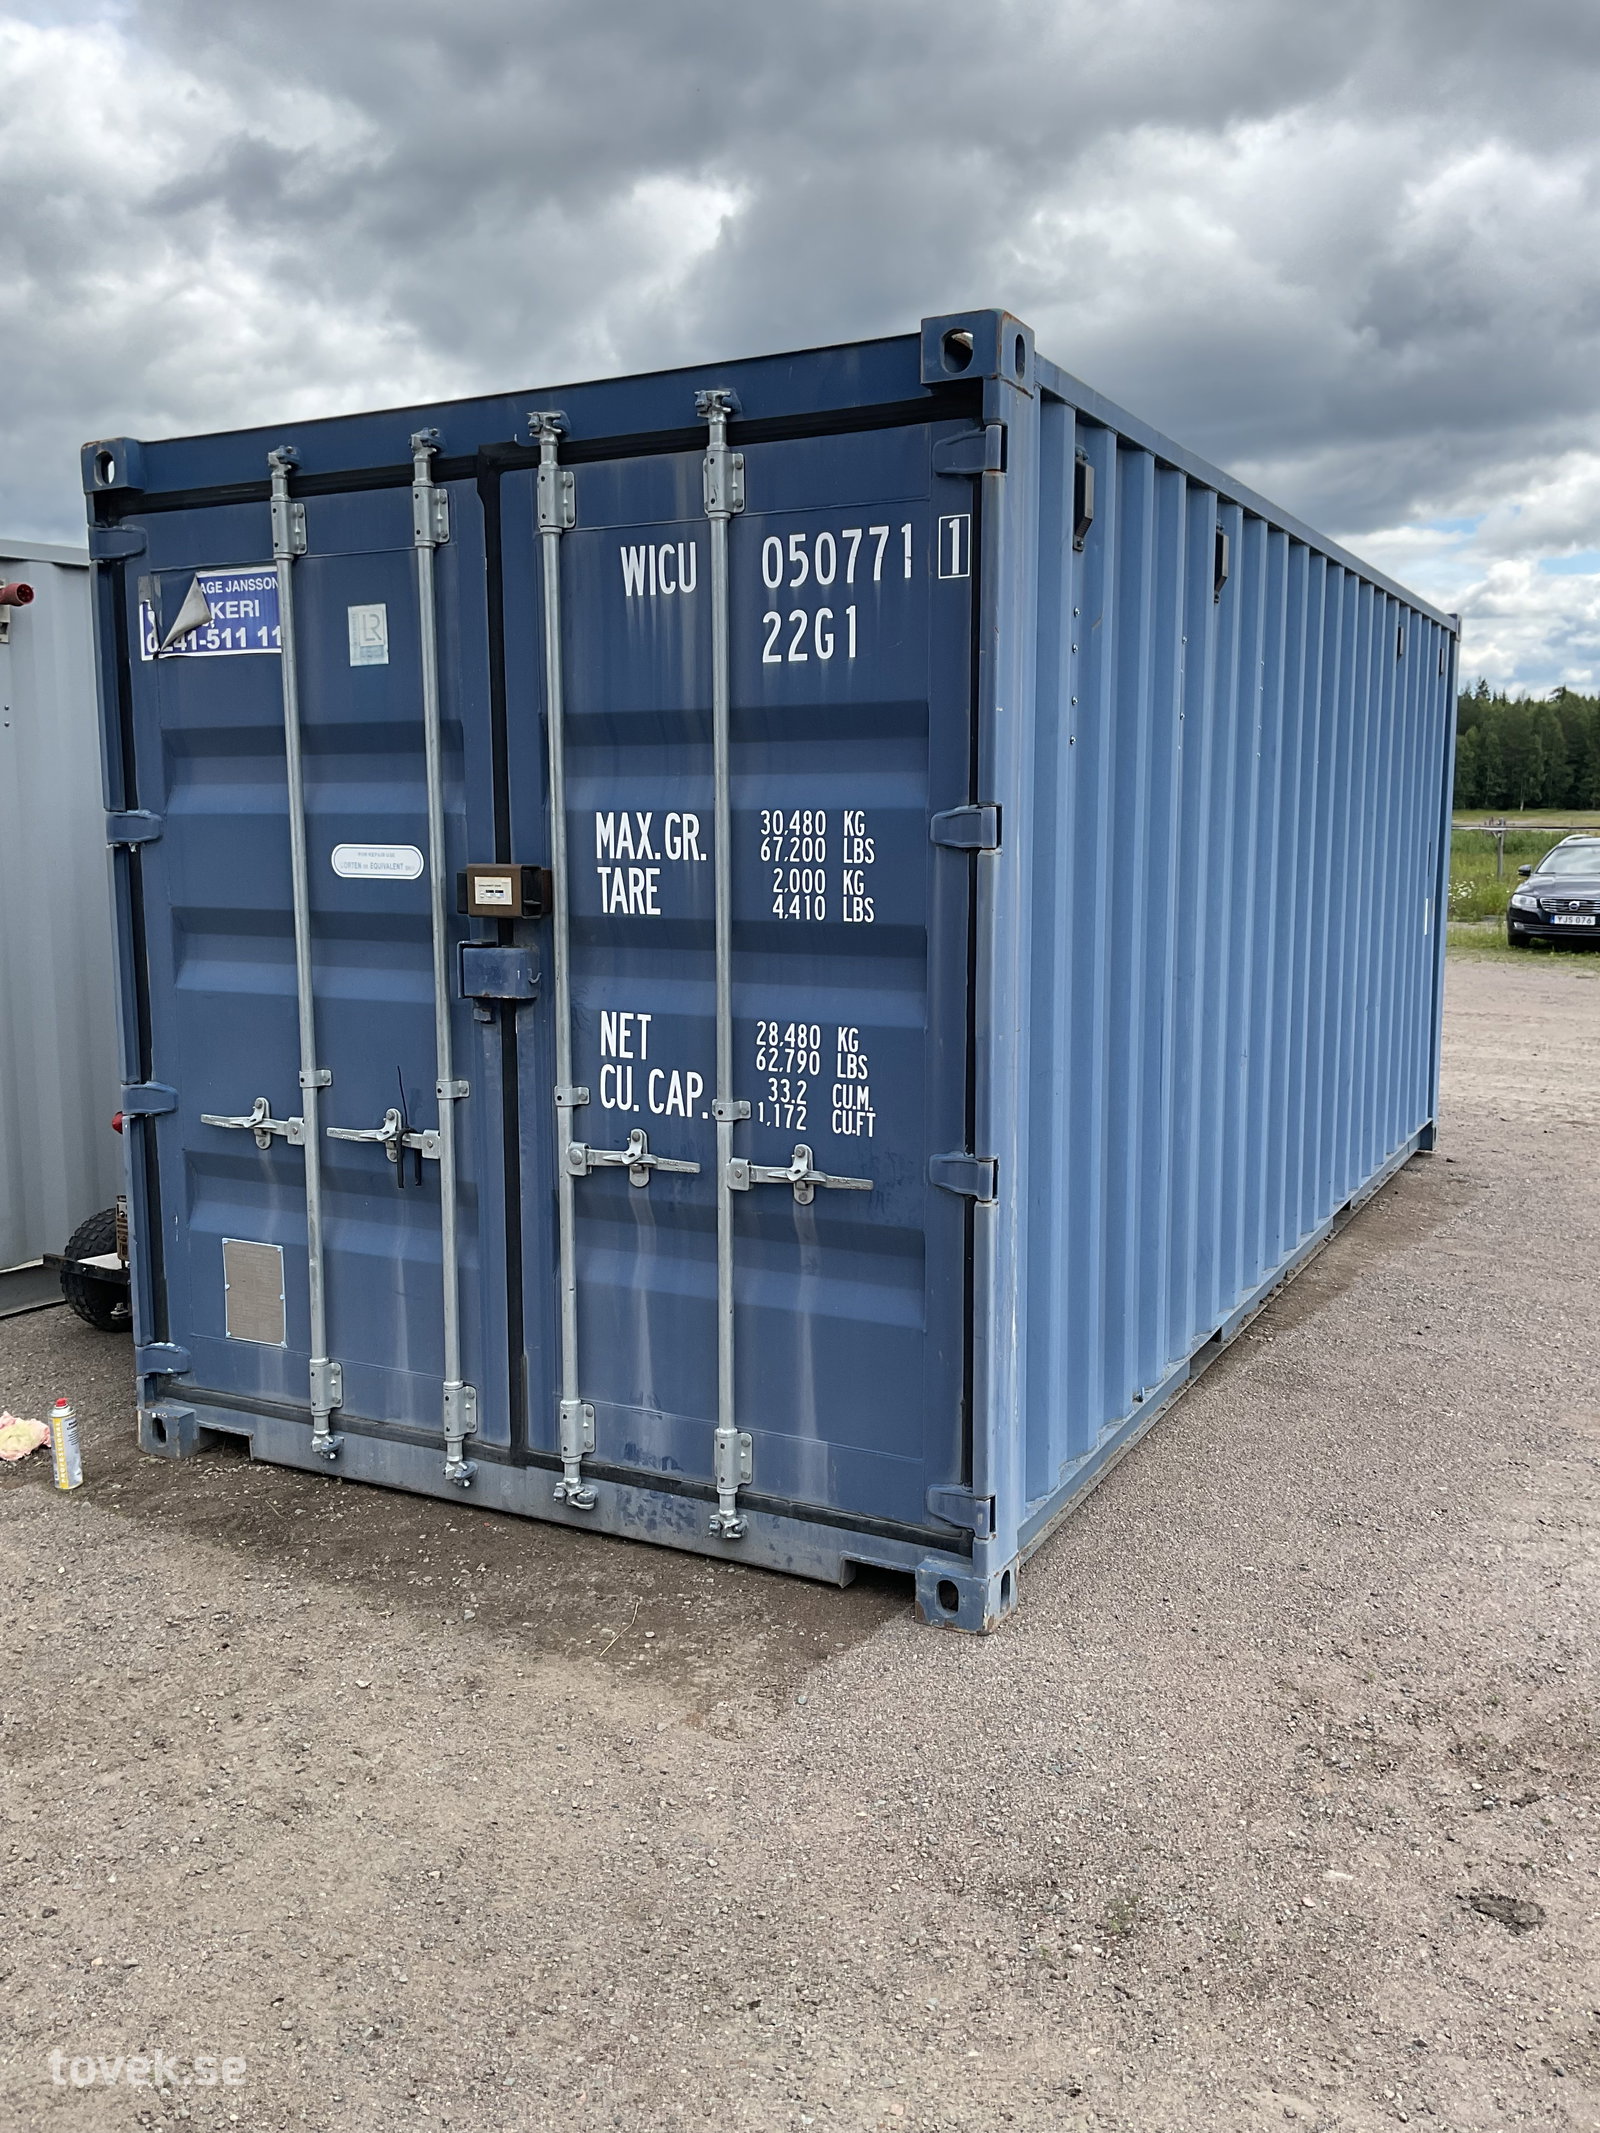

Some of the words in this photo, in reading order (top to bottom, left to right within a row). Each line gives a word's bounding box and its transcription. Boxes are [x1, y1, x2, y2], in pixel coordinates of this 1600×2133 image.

[620, 541, 697, 597] WICU
[762, 523, 913, 589] 050771
[225, 576, 279, 593] JANSSON
[146, 626, 248, 654] 041-511
[257, 625, 282, 647] 11
[762, 605, 857, 663] 22G1
[595, 811, 707, 861] MAX.GR.
[760, 810, 827, 837] 30,480
[843, 810, 866, 837] KG
[760, 836, 827, 863] 67,200
[843, 837, 875, 864] LBS
[370, 862, 404, 871] EQUIVALENT
[597, 867, 662, 916] TARE
[772, 868, 826, 894] 2,000
[843, 869, 865, 896] KG
[772, 894, 826, 921] 4,410
[843, 896, 875, 923] LBS
[600, 1010, 652, 1061] NET
[756, 1021, 821, 1050] 28,480
[837, 1026, 859, 1053] KG
[756, 1047, 821, 1076] 62,790
[837, 1053, 869, 1080] LBS
[600, 1063, 640, 1112] CU.
[648, 1068, 709, 1120] CAP.
[768, 1077, 808, 1105] 33.2
[757, 1101, 808, 1131] 1,172
[831, 1109, 877, 1138] CU.FT
